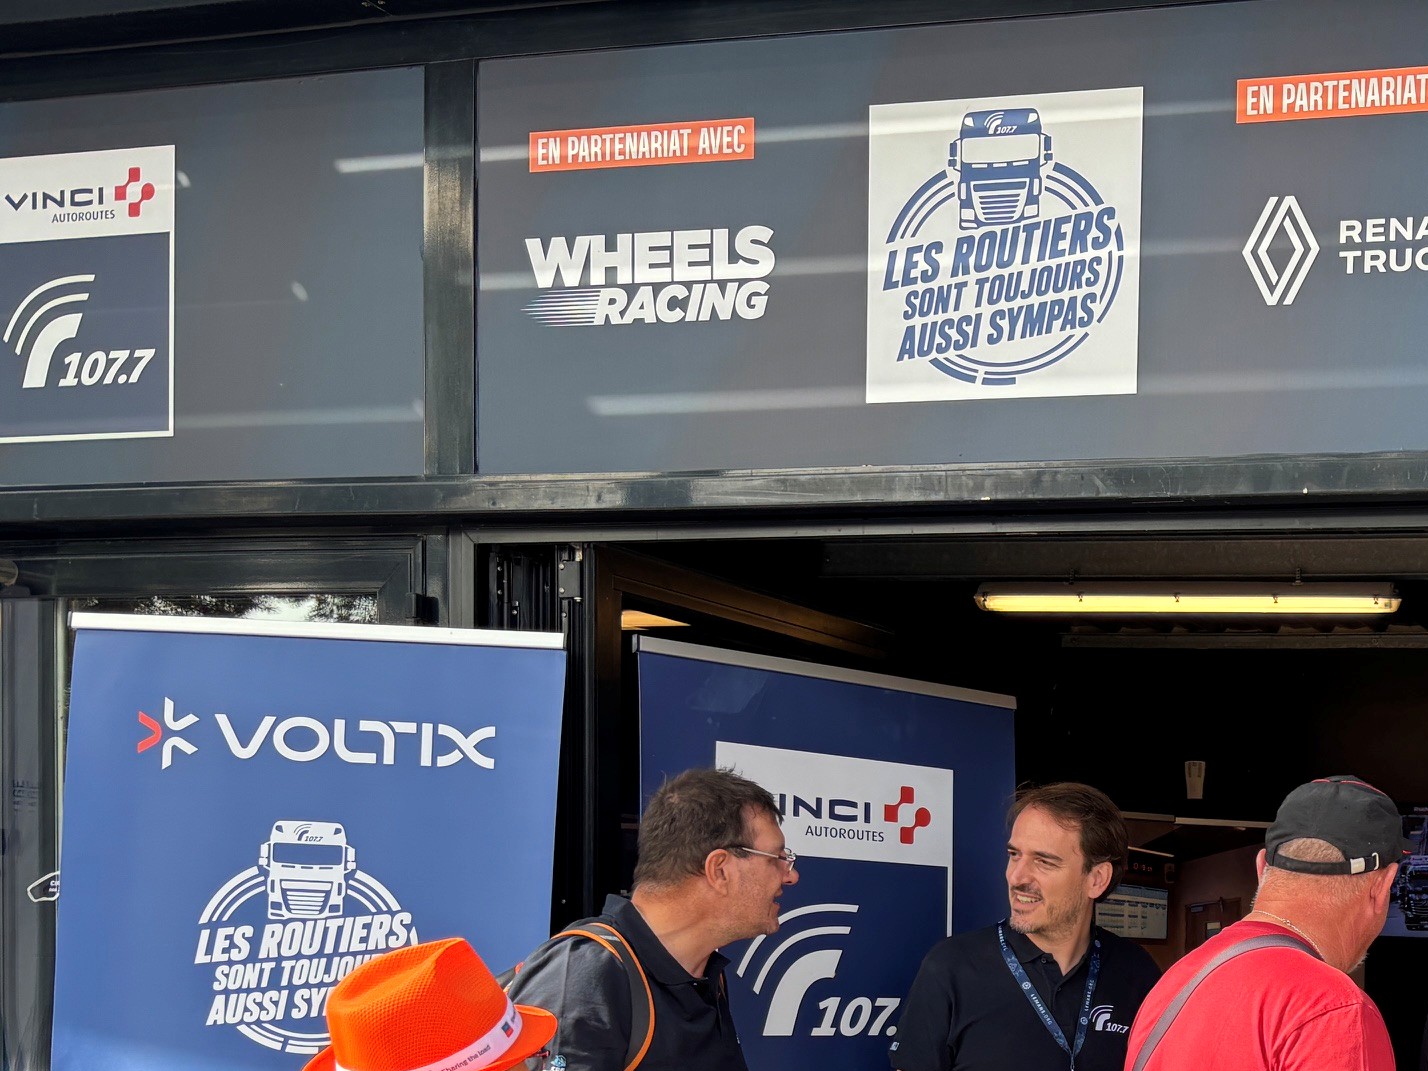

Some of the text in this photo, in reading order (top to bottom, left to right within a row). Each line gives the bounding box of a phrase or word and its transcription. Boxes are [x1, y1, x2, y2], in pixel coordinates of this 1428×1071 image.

[1246, 86, 1274, 116] EN
[1282, 74, 1428, 113] PARTENARIAT
[537, 125, 746, 165] EN PARTENARIAT AVEC
[996, 126, 1017, 134] 107.7
[4, 186, 104, 211] VINCI
[51, 209, 116, 223] AUTOROUTES
[525, 225, 776, 288] WHEELS
[882, 206, 1117, 292] LES ROUTIERS
[595, 281, 770, 325] RACING
[903, 257, 1102, 321] SONT TOUJOURS
[896, 293, 1098, 362] AUSSI SYMPAS
[58, 348, 156, 387] 107.7
[214, 713, 496, 770] VOLTIX
[778, 793, 871, 824] INCI
[805, 825, 884, 842] AUTOROUTES
[194, 912, 412, 964] LES ROUTIERS
[213, 953, 384, 991] SONT TOUJO
[206, 990, 289, 1025] AUSSI
[810, 996, 901, 1036] 107.
[1105, 1022, 1129, 1033] 107.7
[467, 1051, 480, 1063] the
[478, 1044, 492, 1057] load
